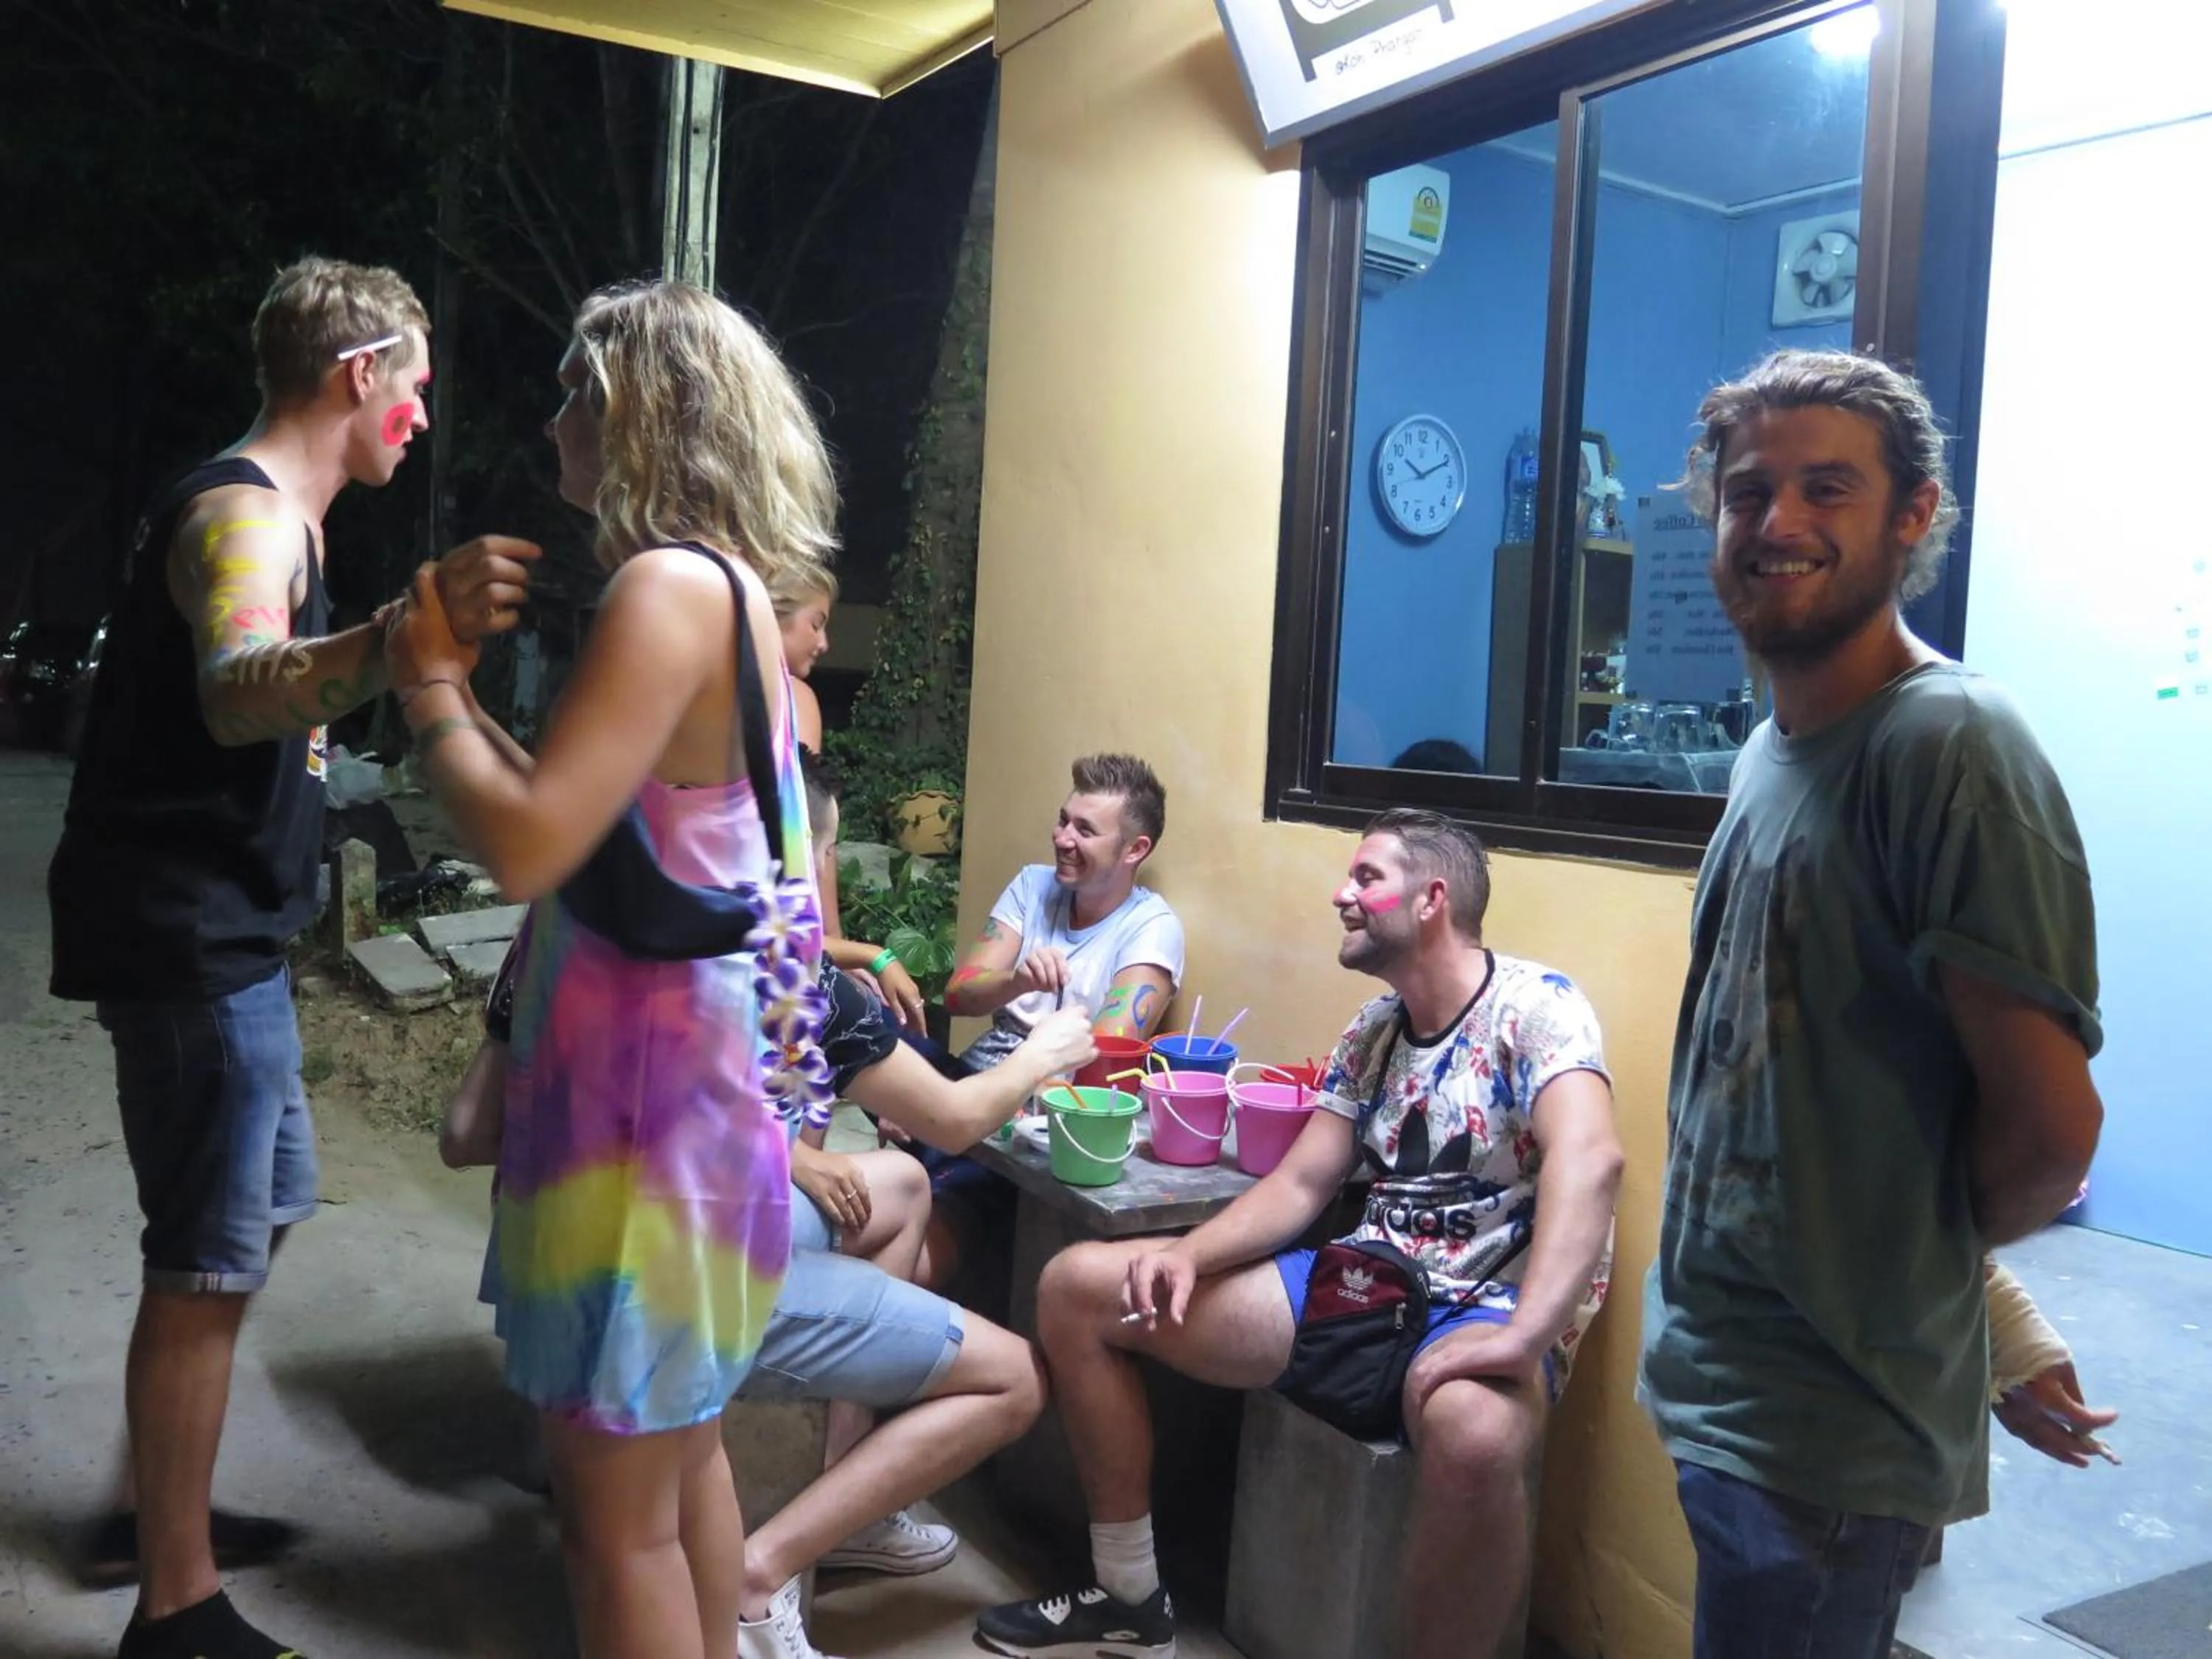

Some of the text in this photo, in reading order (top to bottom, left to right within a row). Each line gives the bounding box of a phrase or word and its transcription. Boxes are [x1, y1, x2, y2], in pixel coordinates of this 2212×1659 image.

[1405, 432, 1412, 448] 11
[1418, 430, 1428, 444] 12
[1394, 444, 1404, 457] 10
[1387, 463, 1394, 476] 9
[1446, 476, 1453, 489] 3
[1391, 484, 1397, 498] 8
[1402, 501, 1408, 514] 7
[1440, 495, 1447, 507] 4
[1414, 509, 1421, 521] 6
[1428, 506, 1435, 519] 5
